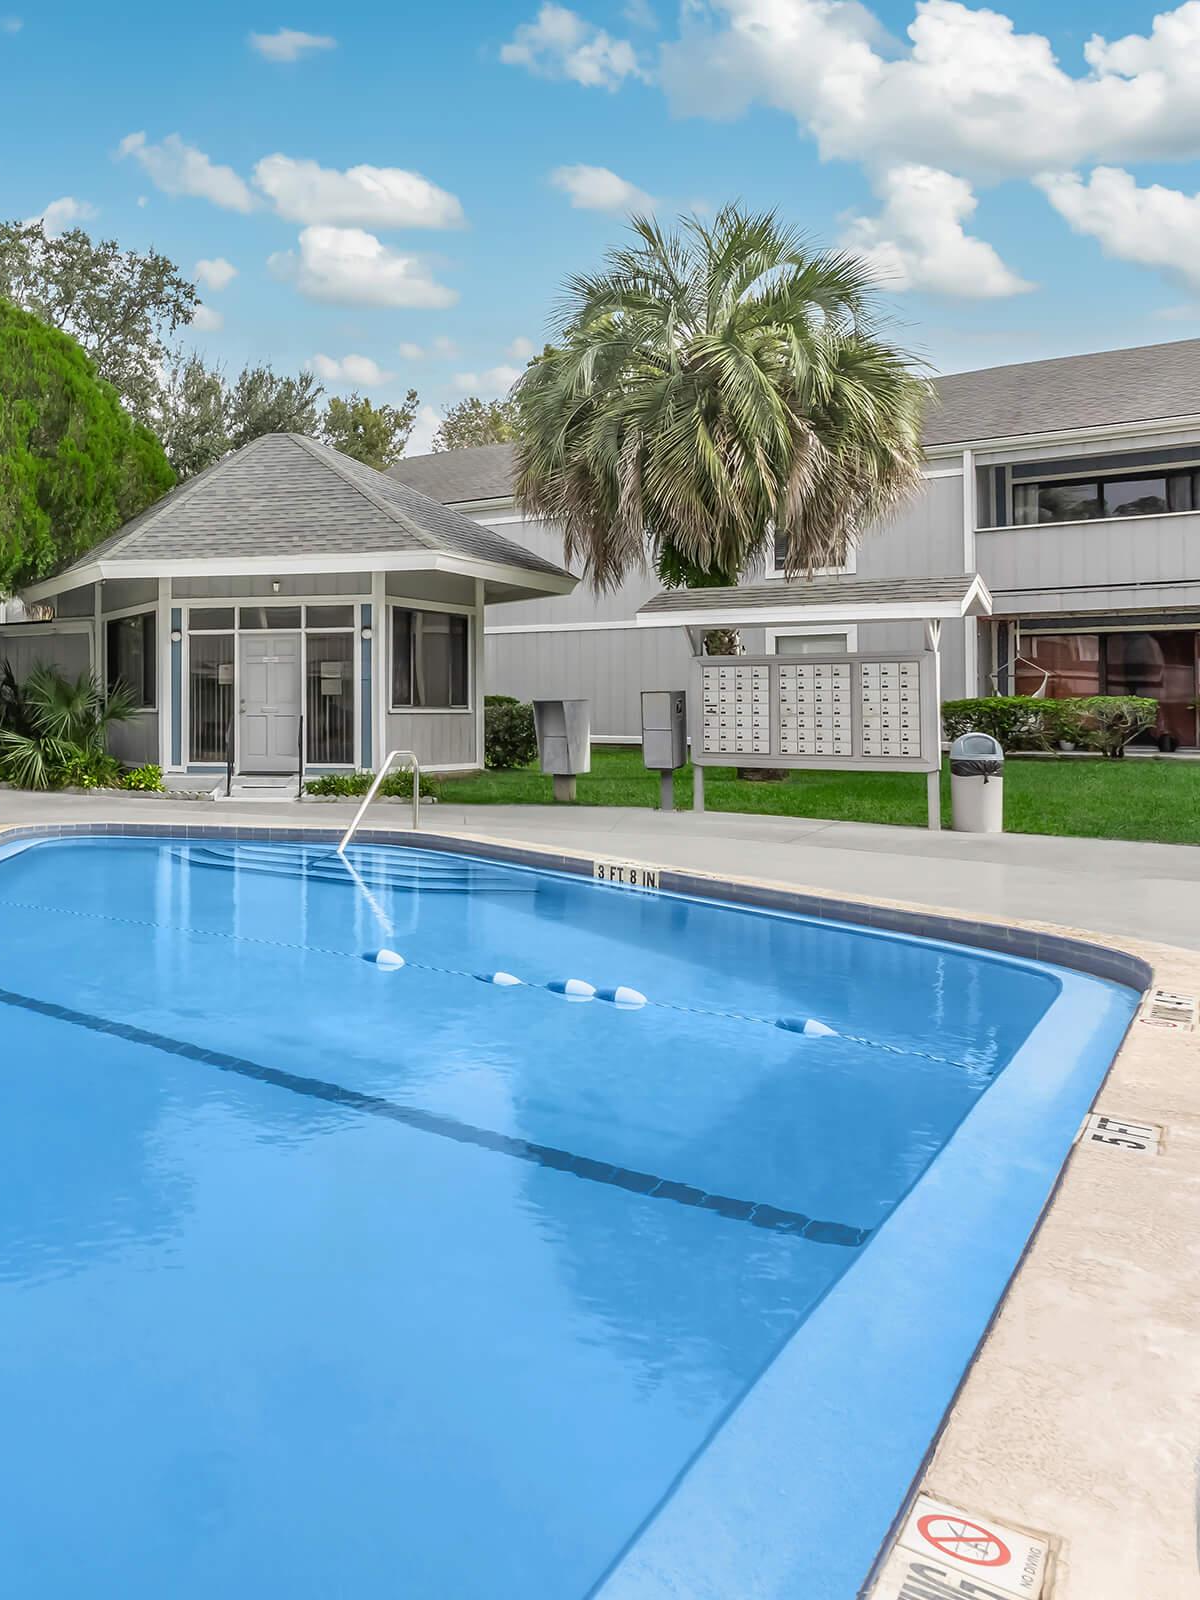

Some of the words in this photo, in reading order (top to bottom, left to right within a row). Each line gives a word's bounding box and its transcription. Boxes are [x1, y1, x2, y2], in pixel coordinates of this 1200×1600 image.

[598, 865, 605, 879] 3
[630, 869, 637, 884] 8
[1097, 1117, 1153, 1139] FT
[1091, 1133, 1147, 1150] 5
[1023, 1547, 1042, 1576] DIVING
[1019, 1574, 1034, 1590] NO
